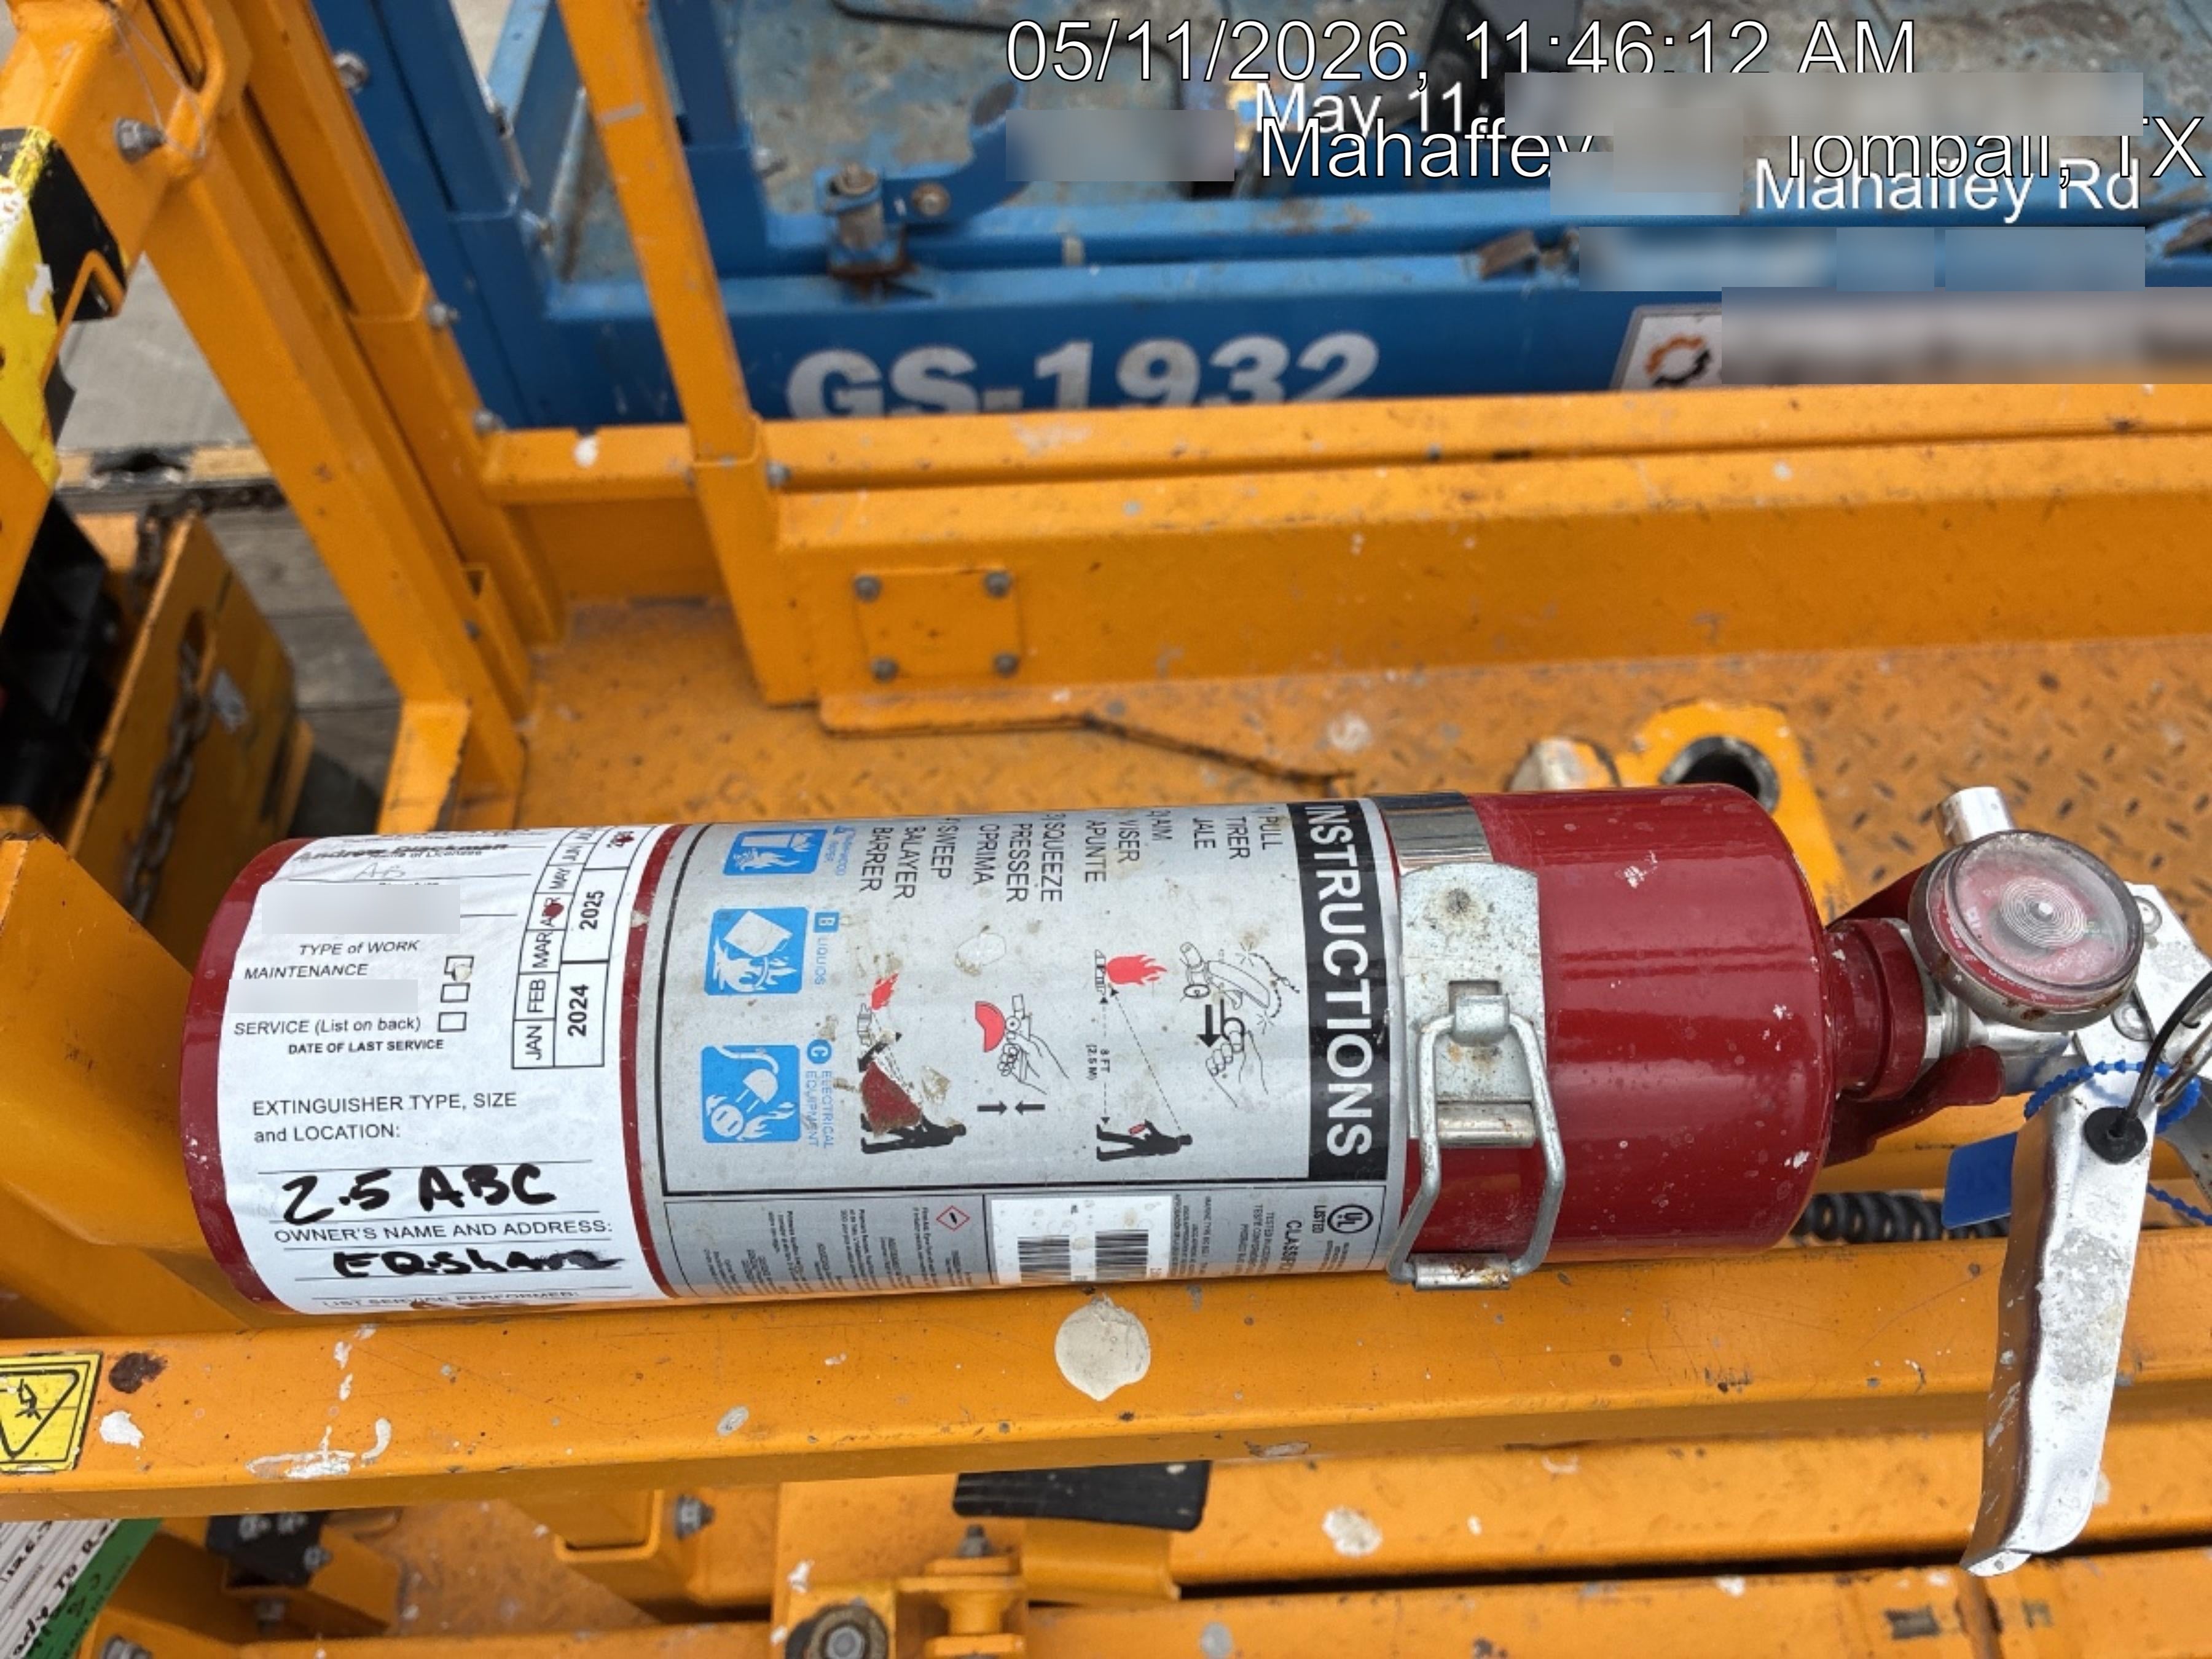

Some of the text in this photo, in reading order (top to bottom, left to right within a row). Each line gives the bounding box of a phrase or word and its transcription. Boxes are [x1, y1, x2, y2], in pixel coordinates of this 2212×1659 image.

[786, 331, 1379, 420] GS-1932
[930, 825, 959, 880] SWEEP
[1084, 819, 1107, 884] APUNTE
[1116, 819, 1140, 864] VISER
[1192, 817, 1216, 850] JALE
[1258, 816, 1284, 850] PULL
[858, 826, 894, 893] BARRER
[893, 825, 926, 900] BALAYER
[973, 824, 1001, 886] OPRIMA
[1006, 823, 1033, 903] PRESSER
[1040, 822, 1066, 903] SQUEEZE
[549, 868, 571, 890] MAY
[578, 890, 605, 930] 2025
[299, 939, 421, 955] TYPE of WORK
[532, 930, 554, 969] MAR
[244, 963, 369, 981] MAINTENANCE
[1303, 805, 1373, 1157] INSTRUCTIONS
[527, 978, 546, 1013] FEB
[567, 984, 590, 1037] 2024
[234, 1016, 422, 1036] SERVICE (List on back)
[525, 1025, 543, 1061] JAN
[288, 1038, 445, 1055] DATE OF LAST SERVICE
[253, 1092, 517, 1116] EXTINGUISHER TYPE, SIZE
[805, 1070, 819, 1147] EQUIPMENT
[821, 1070, 834, 1149] ELECTRICAL
[254, 1123, 401, 1143] and LOCATION:
[281, 1162, 557, 1226] 2.5 ABC
[274, 1220, 613, 1244] OWNER'S NAME AND ADDRESS:
[1312, 1204, 1328, 1234] LISTED
